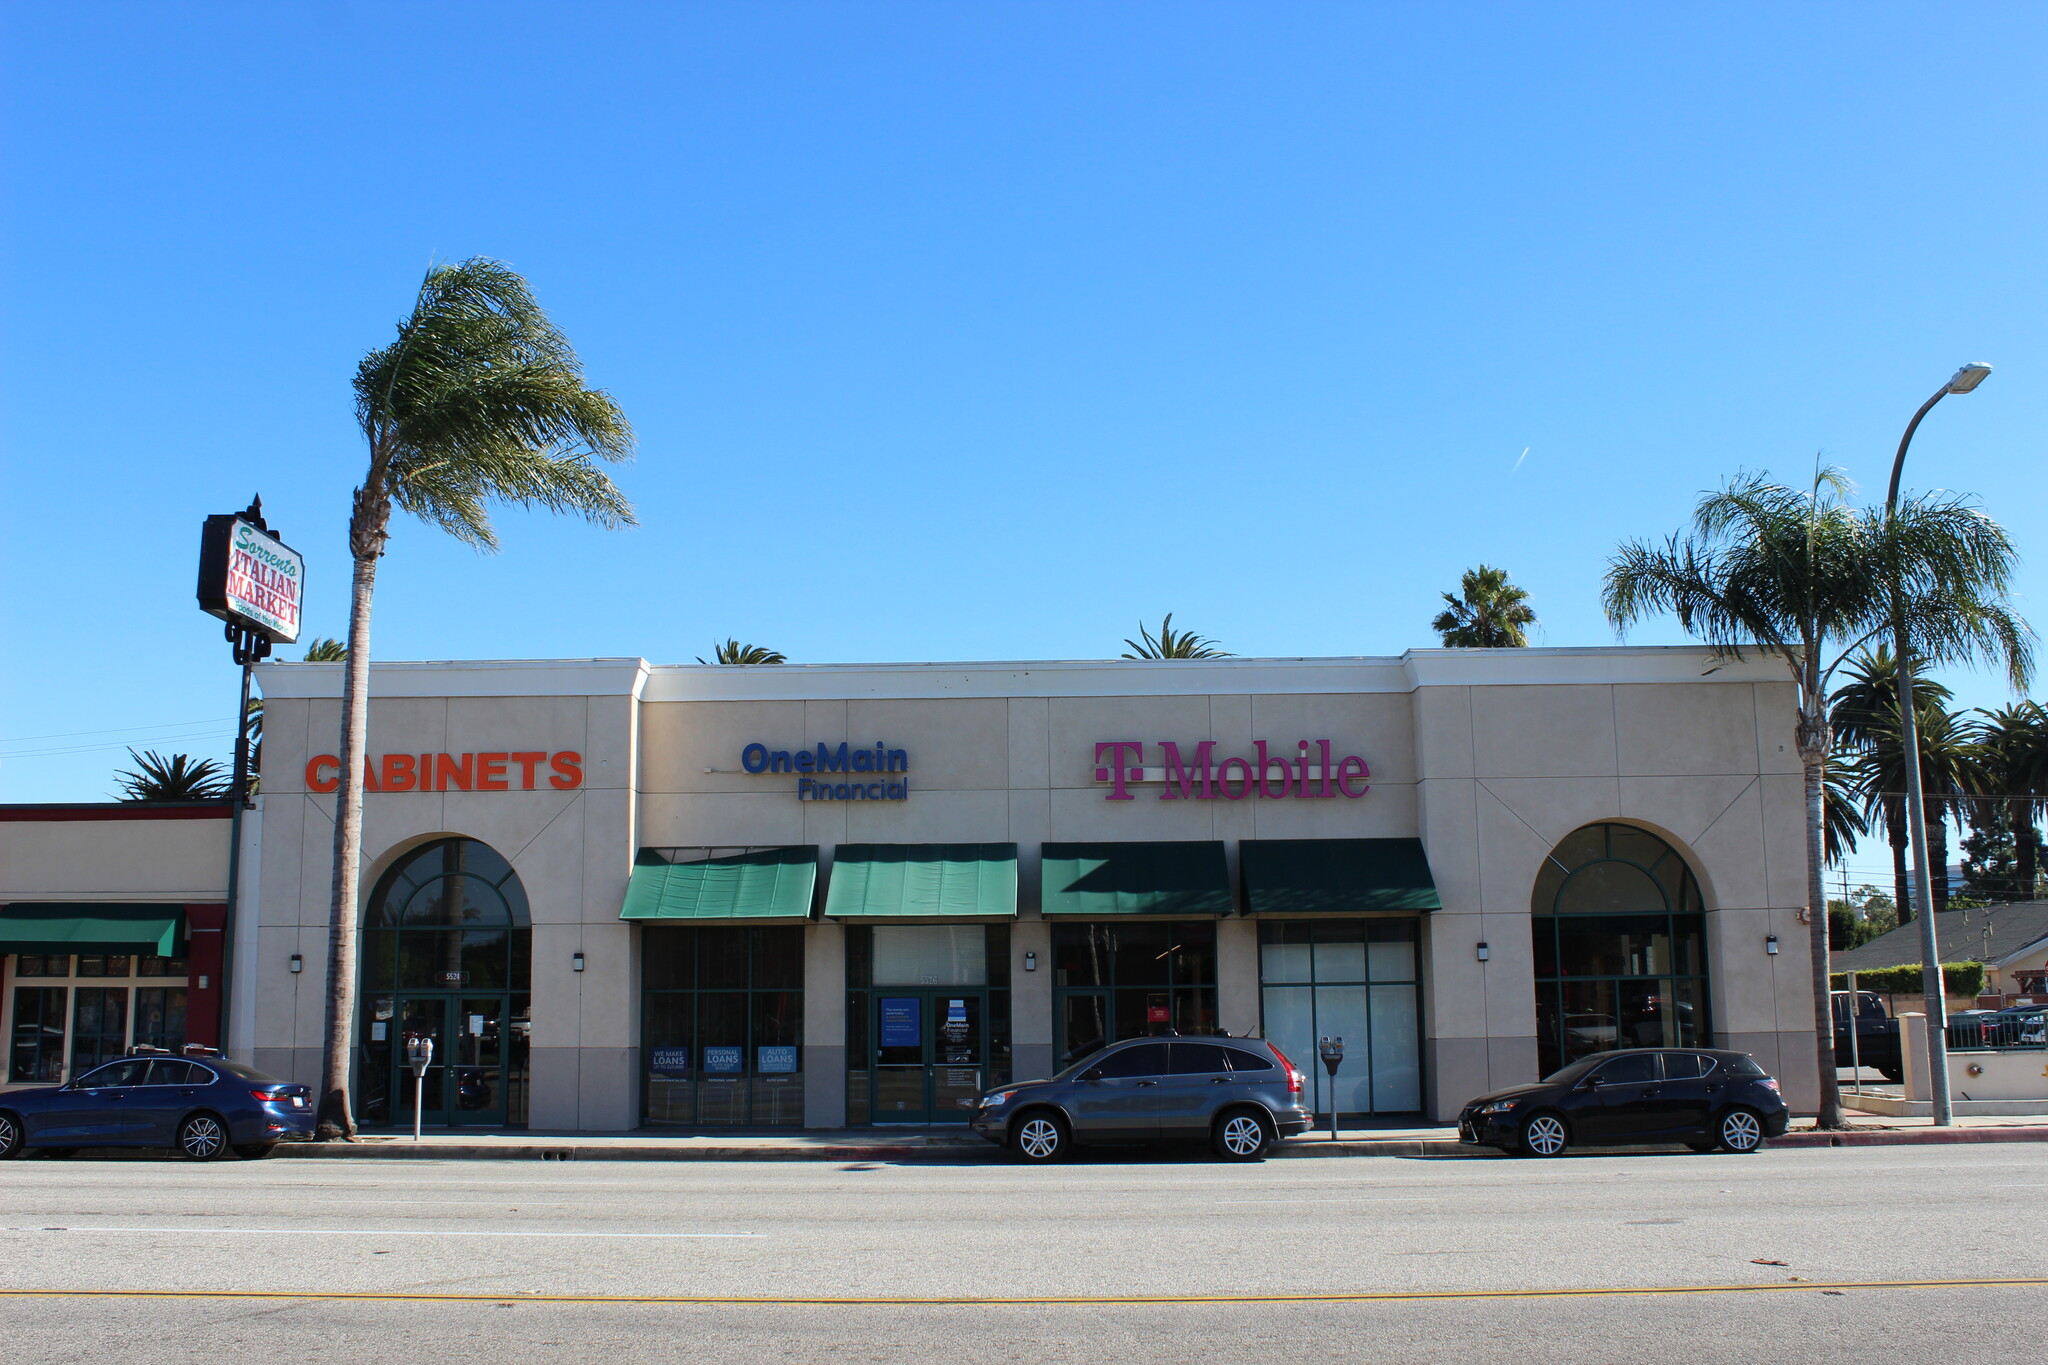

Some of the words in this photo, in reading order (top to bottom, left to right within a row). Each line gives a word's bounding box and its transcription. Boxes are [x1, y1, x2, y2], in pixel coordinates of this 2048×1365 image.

[236, 527, 297, 577] Sorrento
[233, 549, 297, 602] ITALIAN
[228, 571, 298, 625] MARKET
[742, 741, 909, 774] OneMain
[798, 777, 909, 801] Financial
[653, 1057, 685, 1065] LOANS
[707, 1055, 738, 1064] LOANS
[761, 1055, 793, 1064] LOANS
